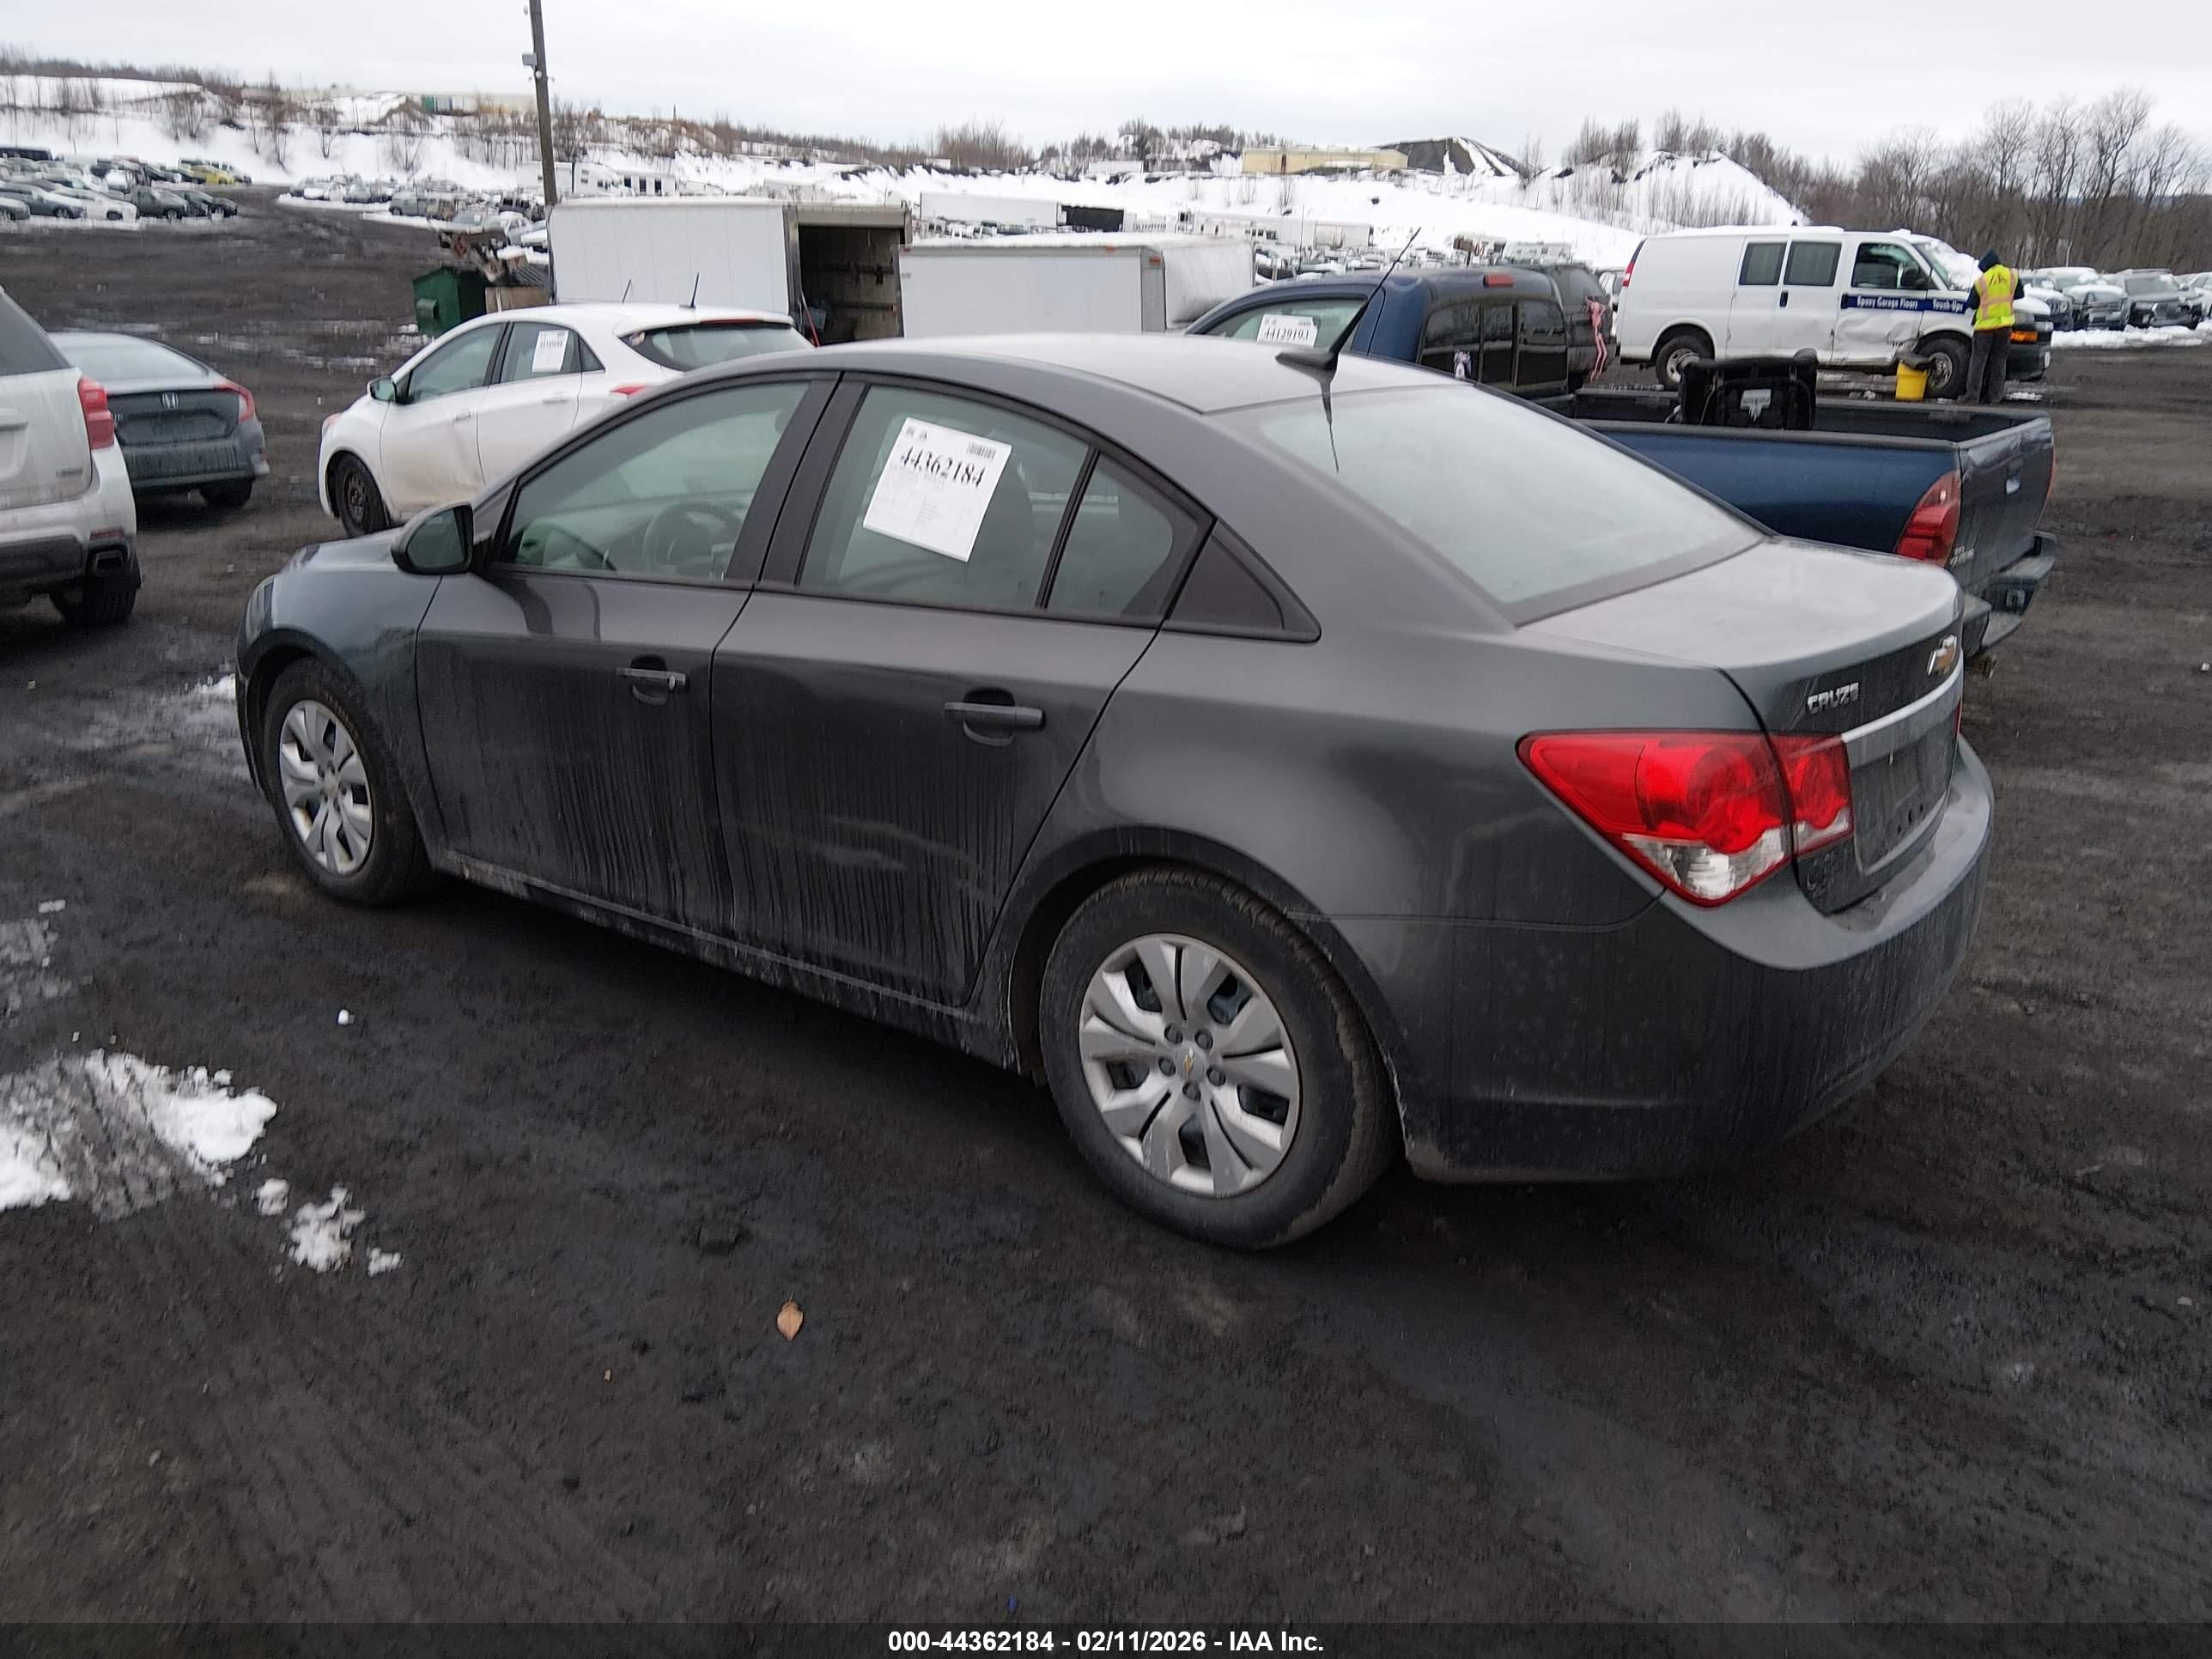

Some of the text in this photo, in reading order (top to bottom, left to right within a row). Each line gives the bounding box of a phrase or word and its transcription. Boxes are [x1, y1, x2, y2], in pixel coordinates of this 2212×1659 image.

[1877, 296, 1899, 310] Garage
[901, 446, 986, 489] 44362184
[1807, 682, 1859, 714] CRUZE
